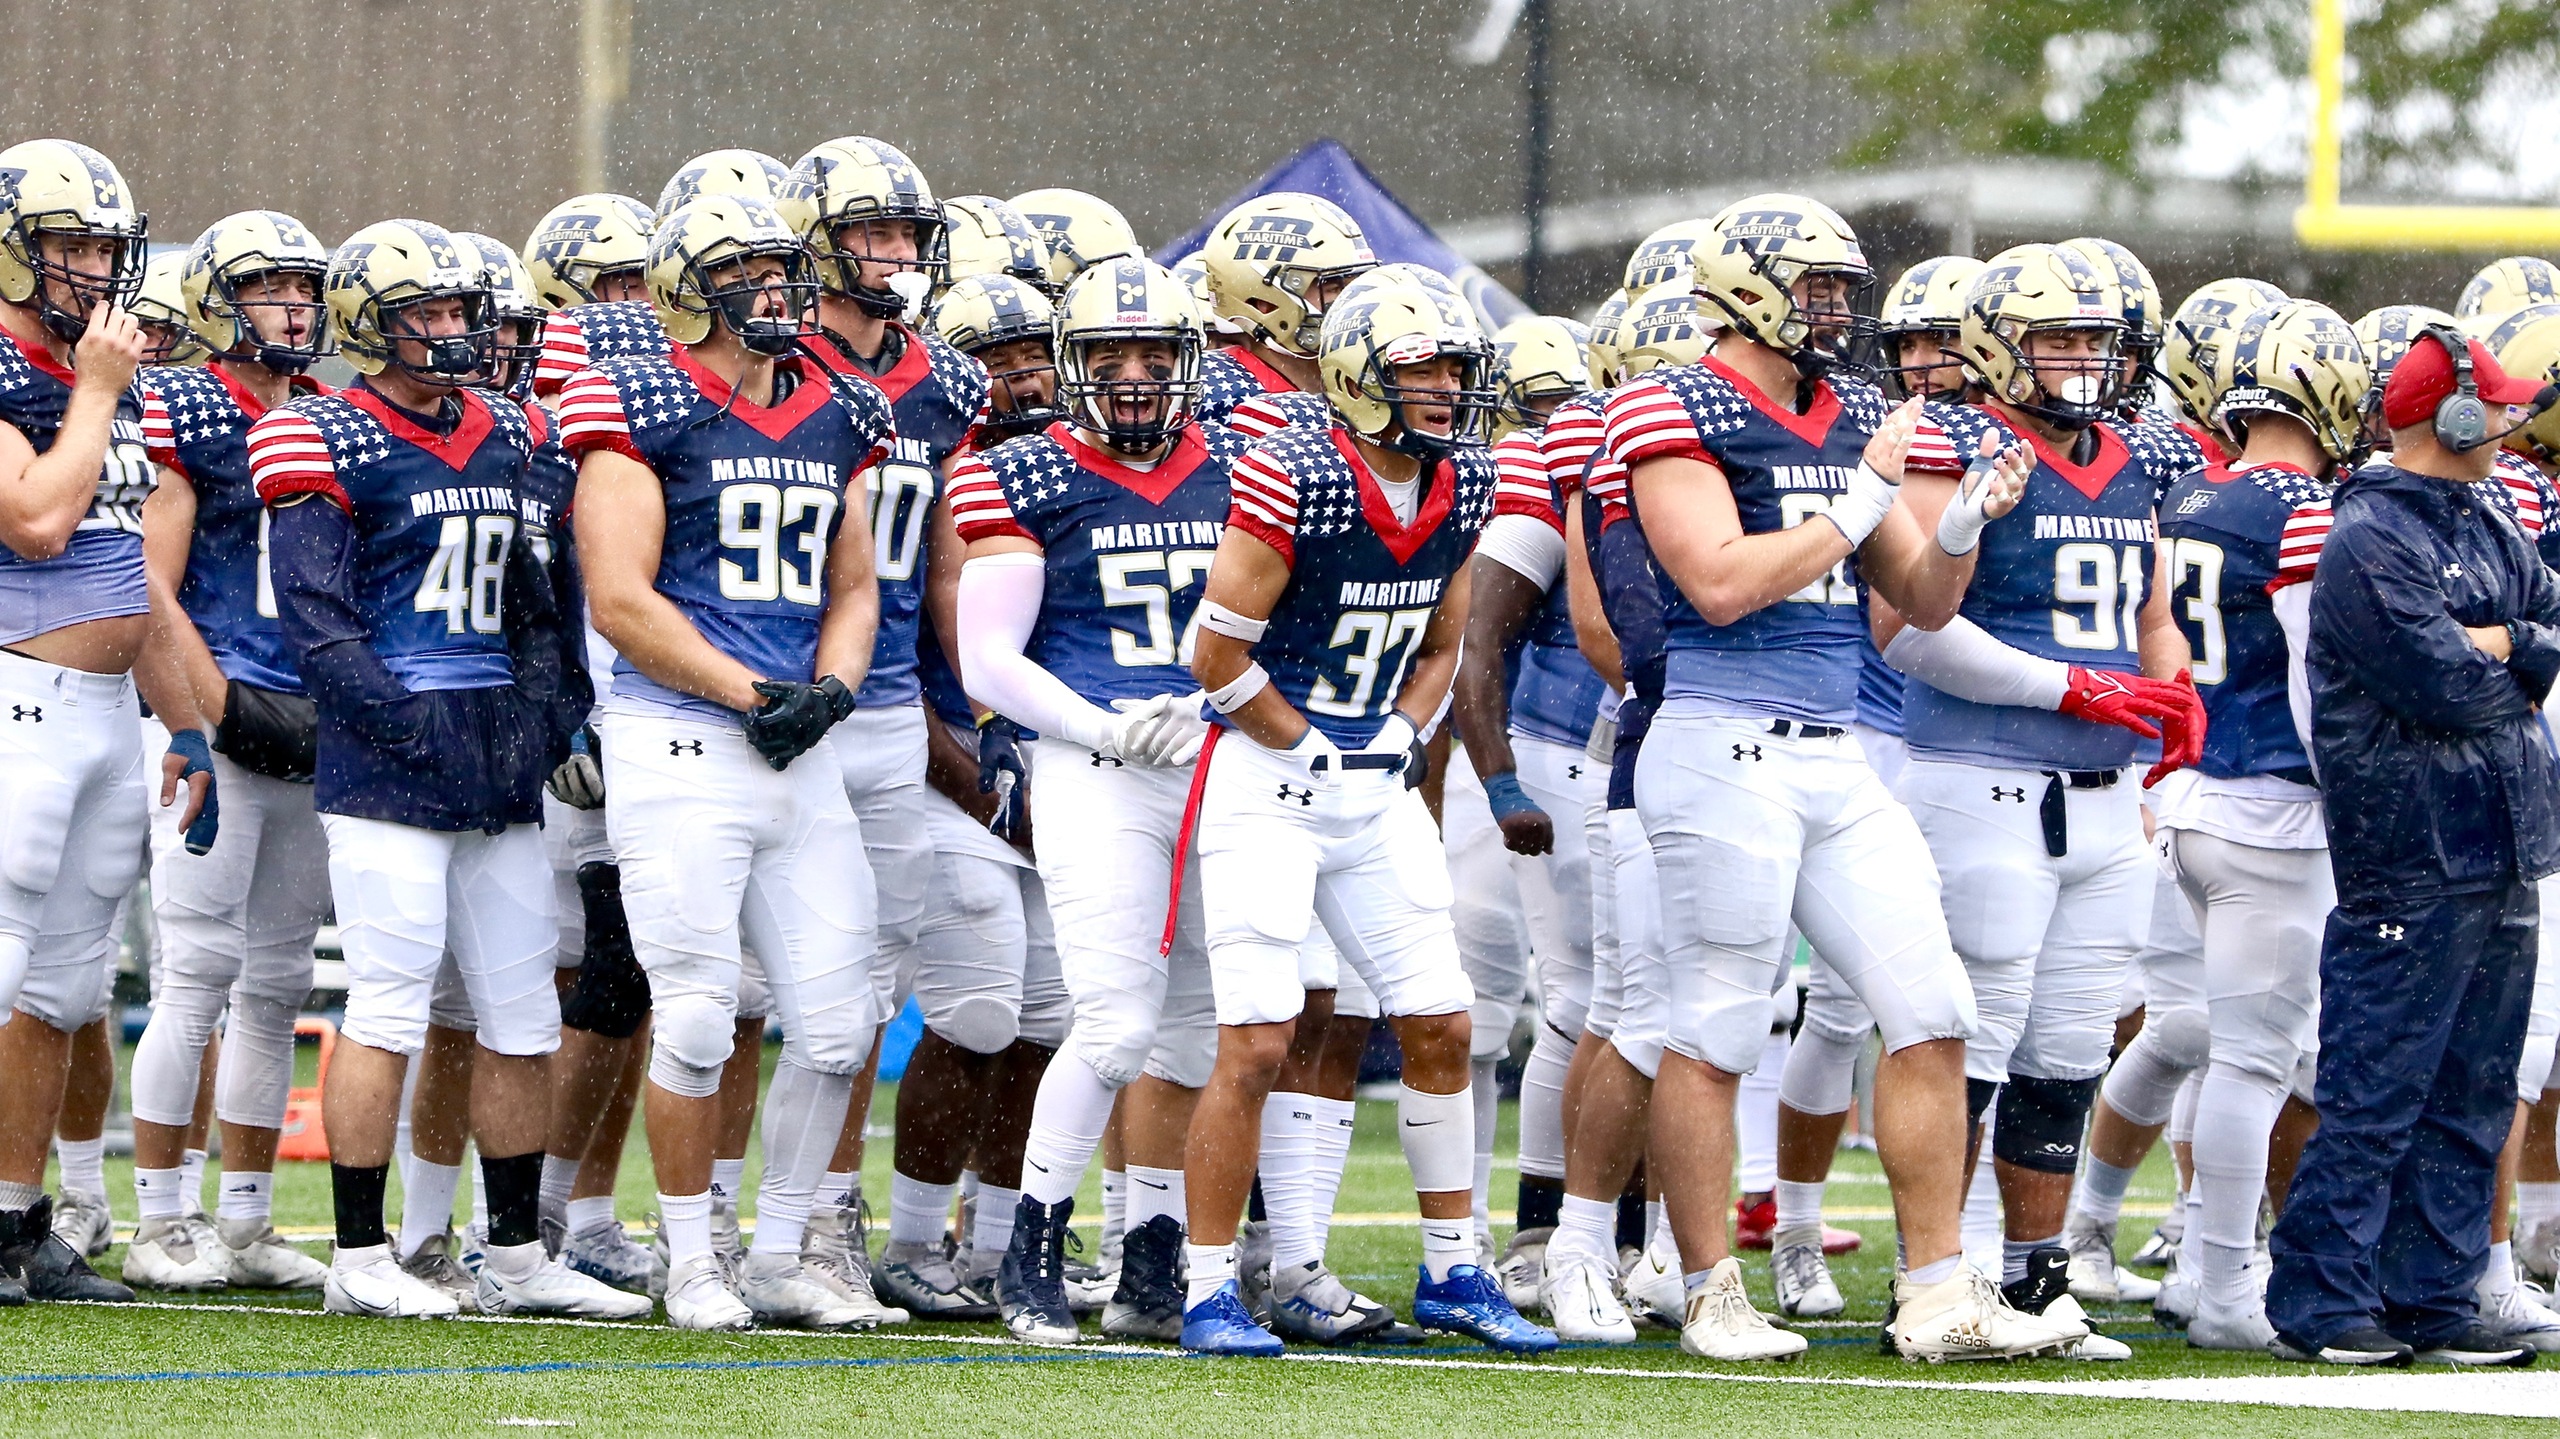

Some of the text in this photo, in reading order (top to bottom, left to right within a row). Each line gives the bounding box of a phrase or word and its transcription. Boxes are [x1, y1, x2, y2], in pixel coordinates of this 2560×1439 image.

[1242, 232, 1304, 246] MARITIME
[1729, 225, 1794, 238] MARITIME
[1637, 254, 1675, 269] MARITIM
[1117, 315, 1147, 323] Riddell
[1640, 313, 1690, 330] MARITIM
[2226, 386, 2269, 401] schutt
[711, 457, 838, 487] MARITIME
[1772, 466, 1857, 489] MARITI
[410, 487, 518, 517] MARITIME
[2034, 515, 2154, 542] MARITIME
[719, 483, 838, 606] 93
[414, 515, 516, 634] 48
[1339, 578, 1442, 606] MARITIME
[2052, 543, 2144, 653] 91
[2158, 538, 2228, 685] 3
[1306, 607, 1434, 718] 37
[1941, 1333, 1991, 1348] adidas
